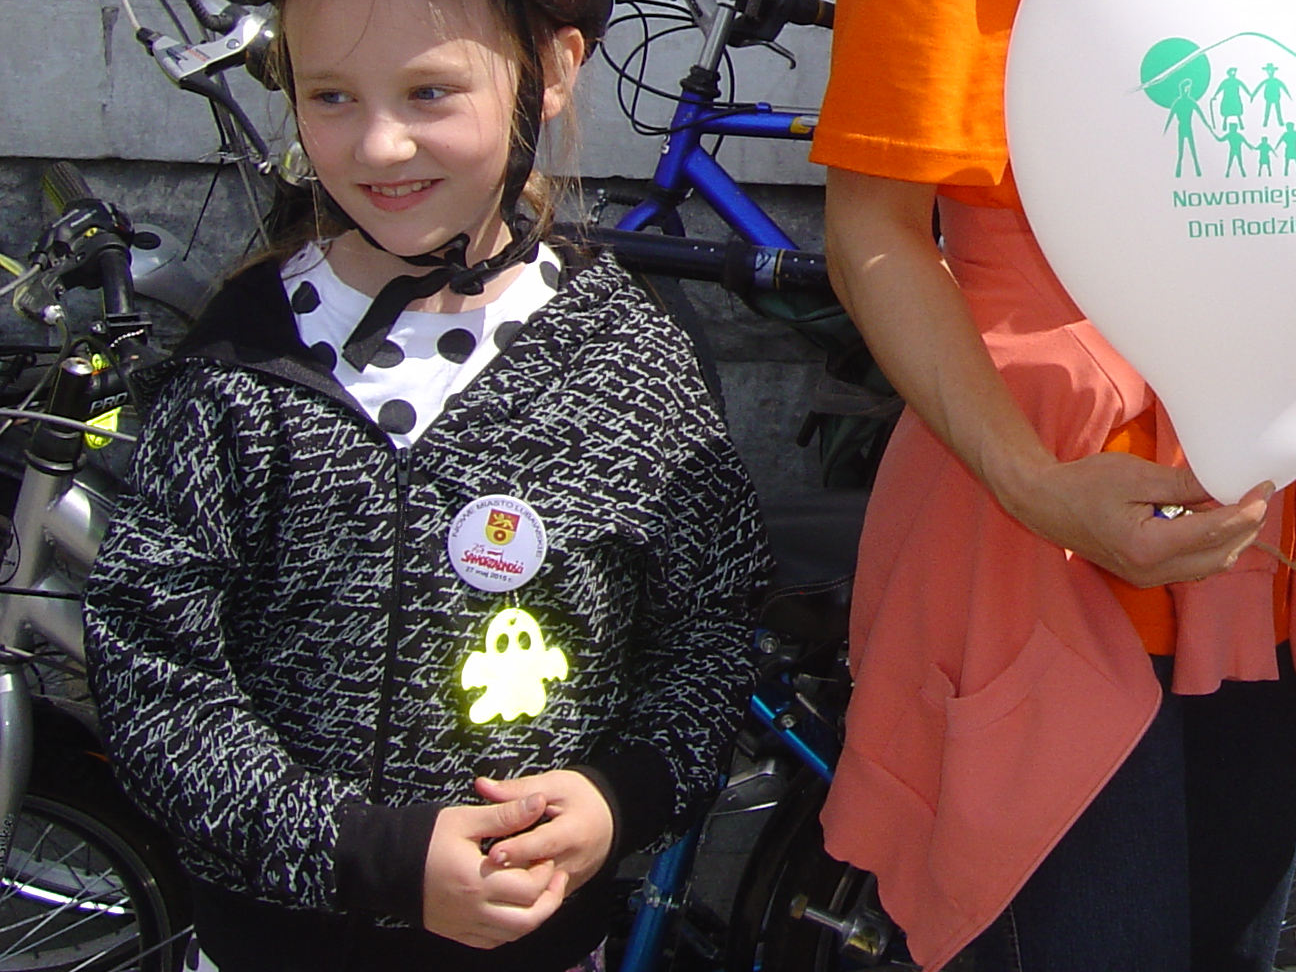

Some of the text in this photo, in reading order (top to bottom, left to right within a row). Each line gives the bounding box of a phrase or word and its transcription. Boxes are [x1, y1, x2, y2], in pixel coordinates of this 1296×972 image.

[1188, 219, 1224, 239] Dni
[90, 392, 128, 415] PRO
[452, 500, 543, 558] NOWE MIASTO LUBAWSKIE
